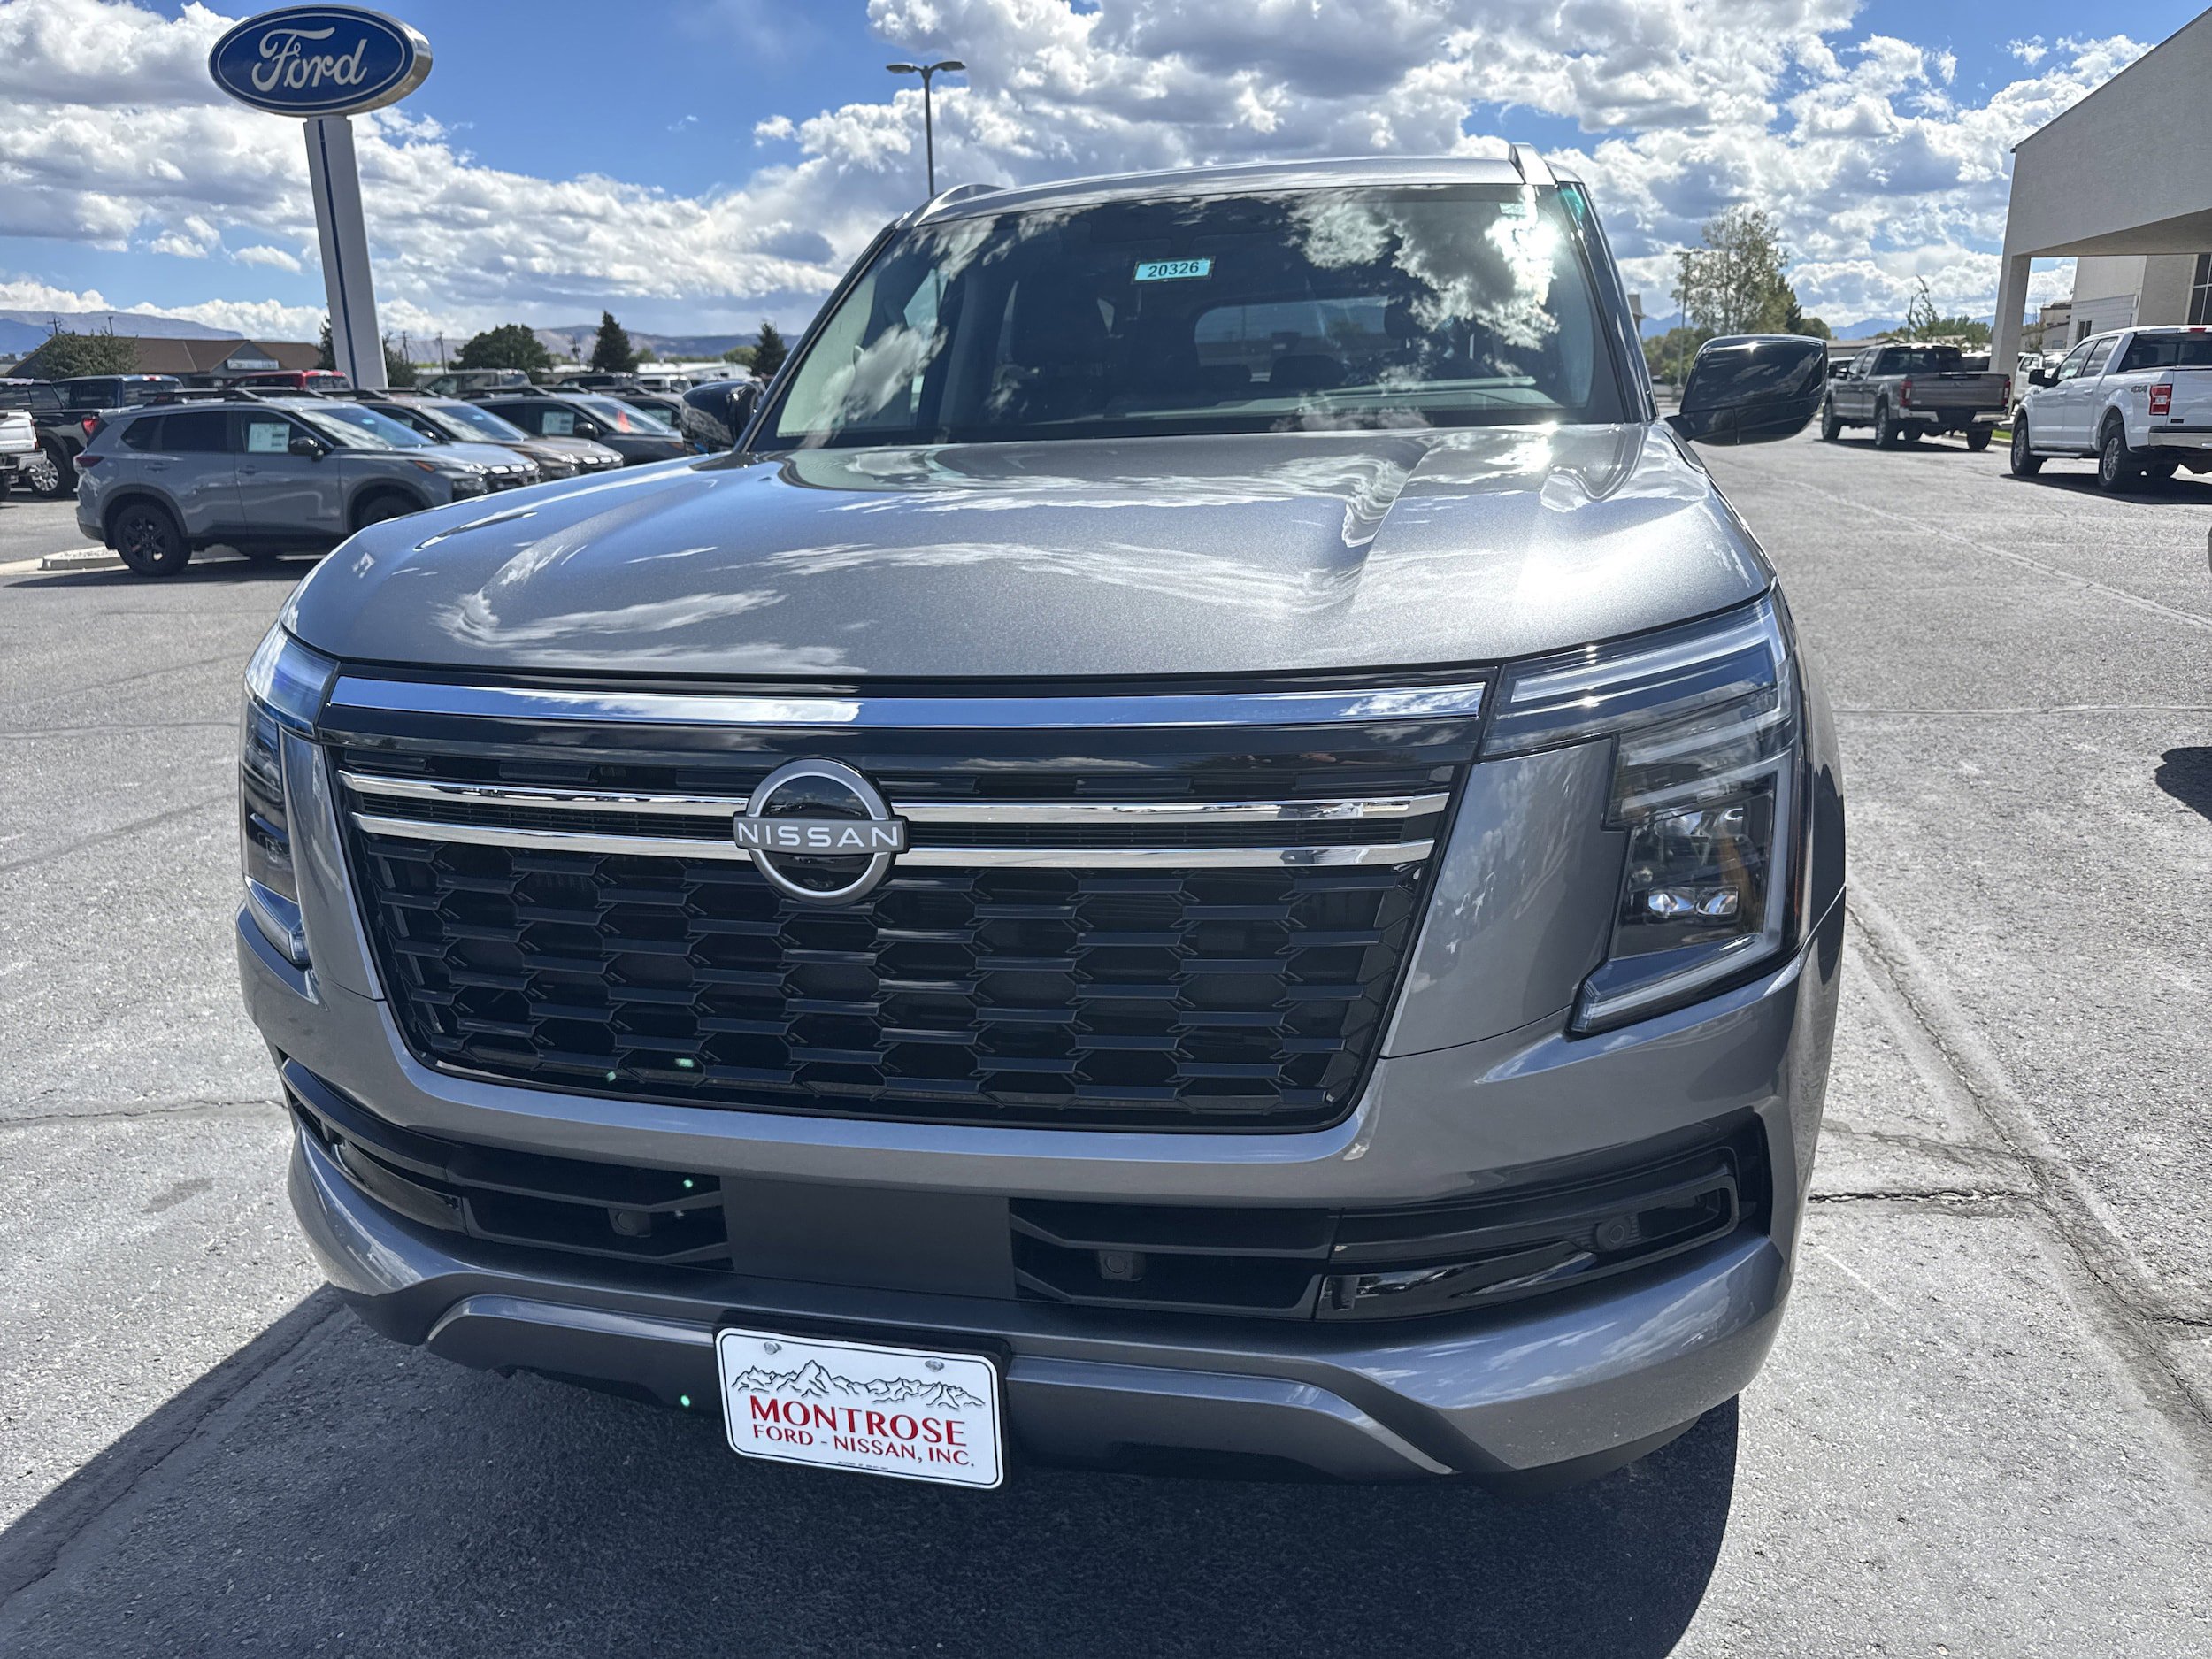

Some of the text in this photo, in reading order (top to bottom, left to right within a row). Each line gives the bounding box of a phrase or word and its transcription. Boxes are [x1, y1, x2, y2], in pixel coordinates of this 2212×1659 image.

[251, 27, 367, 92] Ford
[1147, 261, 1200, 278] 20326
[737, 822, 899, 848] NISSAN
[749, 1395, 967, 1447] MONTROSE
[753, 1423, 814, 1446] FORD
[833, 1435, 923, 1463] NISSAN,
[928, 1447, 975, 1468] INC.
